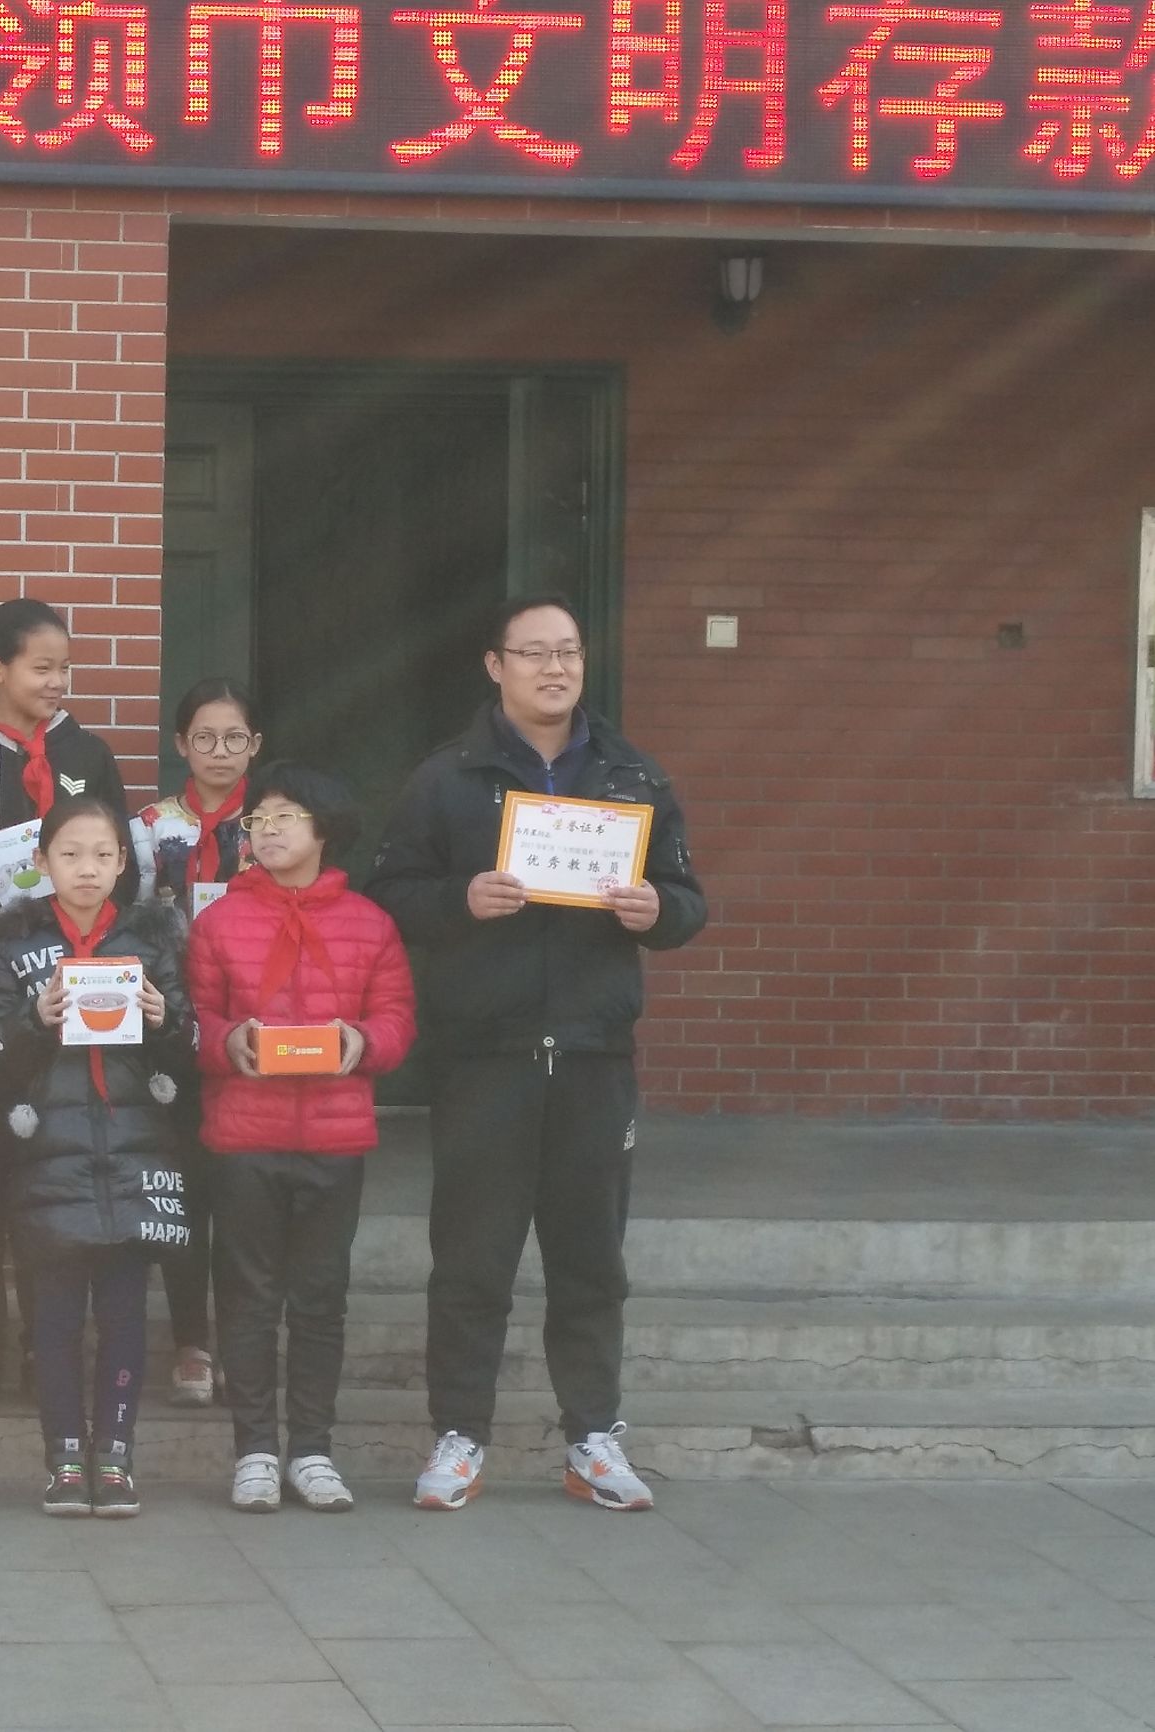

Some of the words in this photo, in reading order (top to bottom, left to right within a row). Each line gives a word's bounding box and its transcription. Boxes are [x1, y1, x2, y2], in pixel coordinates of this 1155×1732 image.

[526, 853, 621, 875] 优秀教练员
[11, 944, 65, 979] LIVE
[141, 1170, 185, 1193] LOVE
[146, 1196, 186, 1216] YOE
[140, 1221, 192, 1247] HAPPY
